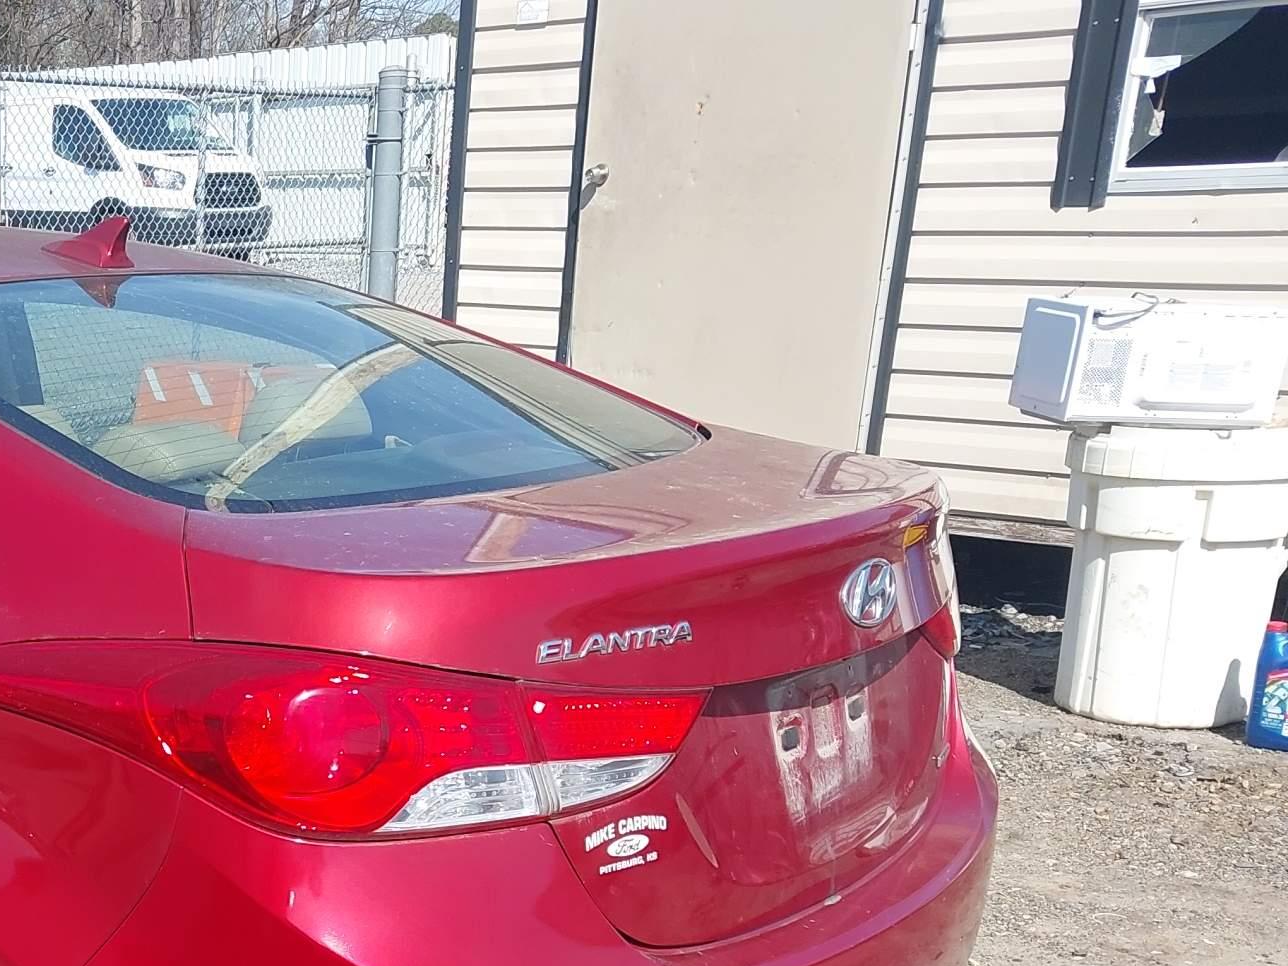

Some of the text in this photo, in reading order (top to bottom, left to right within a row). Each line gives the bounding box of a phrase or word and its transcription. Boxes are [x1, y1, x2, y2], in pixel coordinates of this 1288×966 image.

[536, 620, 693, 664] ELANTRA
[585, 815, 667, 852] MIKE CARPINO
[615, 838, 641, 854] Ford
